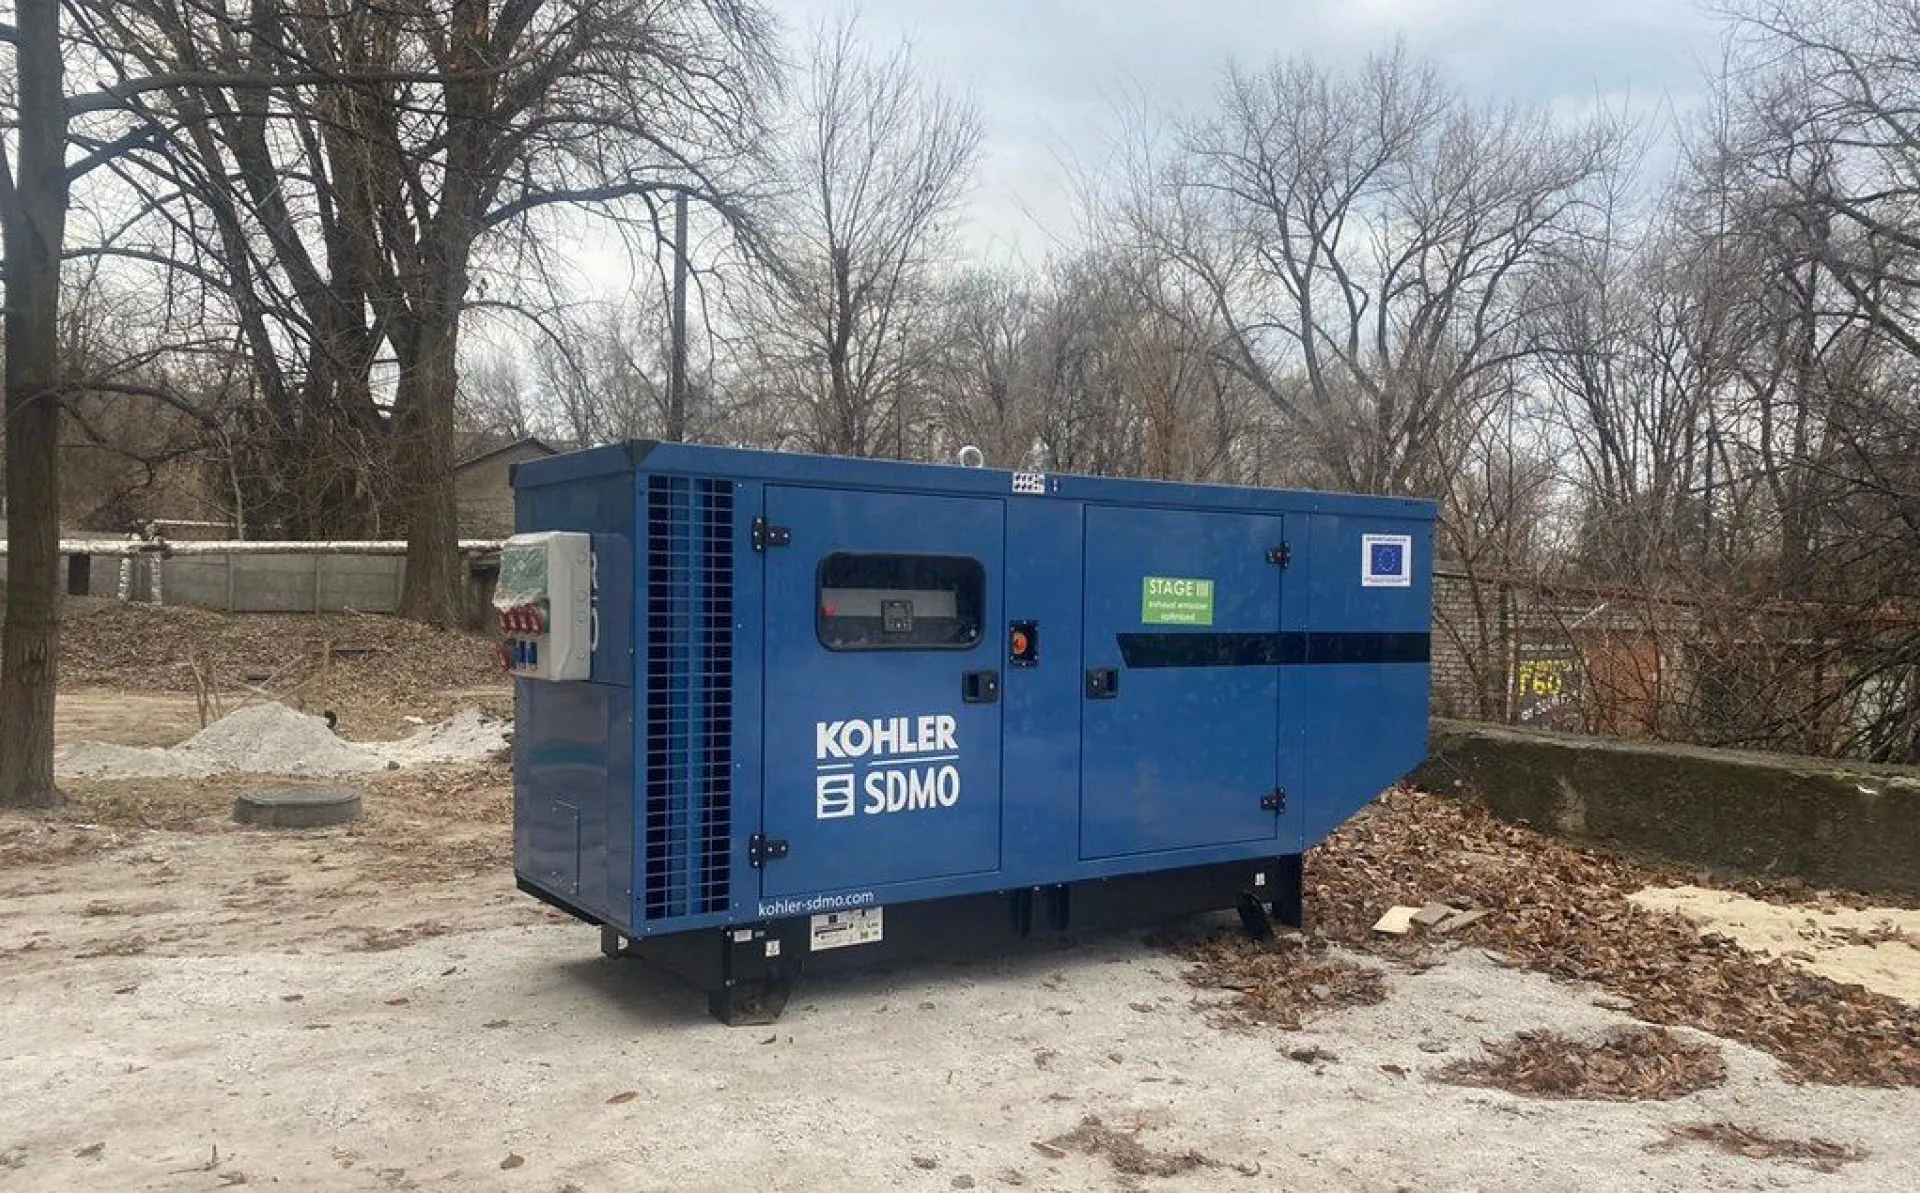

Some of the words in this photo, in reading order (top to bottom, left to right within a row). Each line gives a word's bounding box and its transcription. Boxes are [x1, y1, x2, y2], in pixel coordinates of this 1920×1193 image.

[1149, 579, 1194, 597] STAGE
[816, 714, 959, 760] KOHLER
[863, 764, 961, 815] SDMO
[758, 891, 875, 917] kohler-sdmo.com
